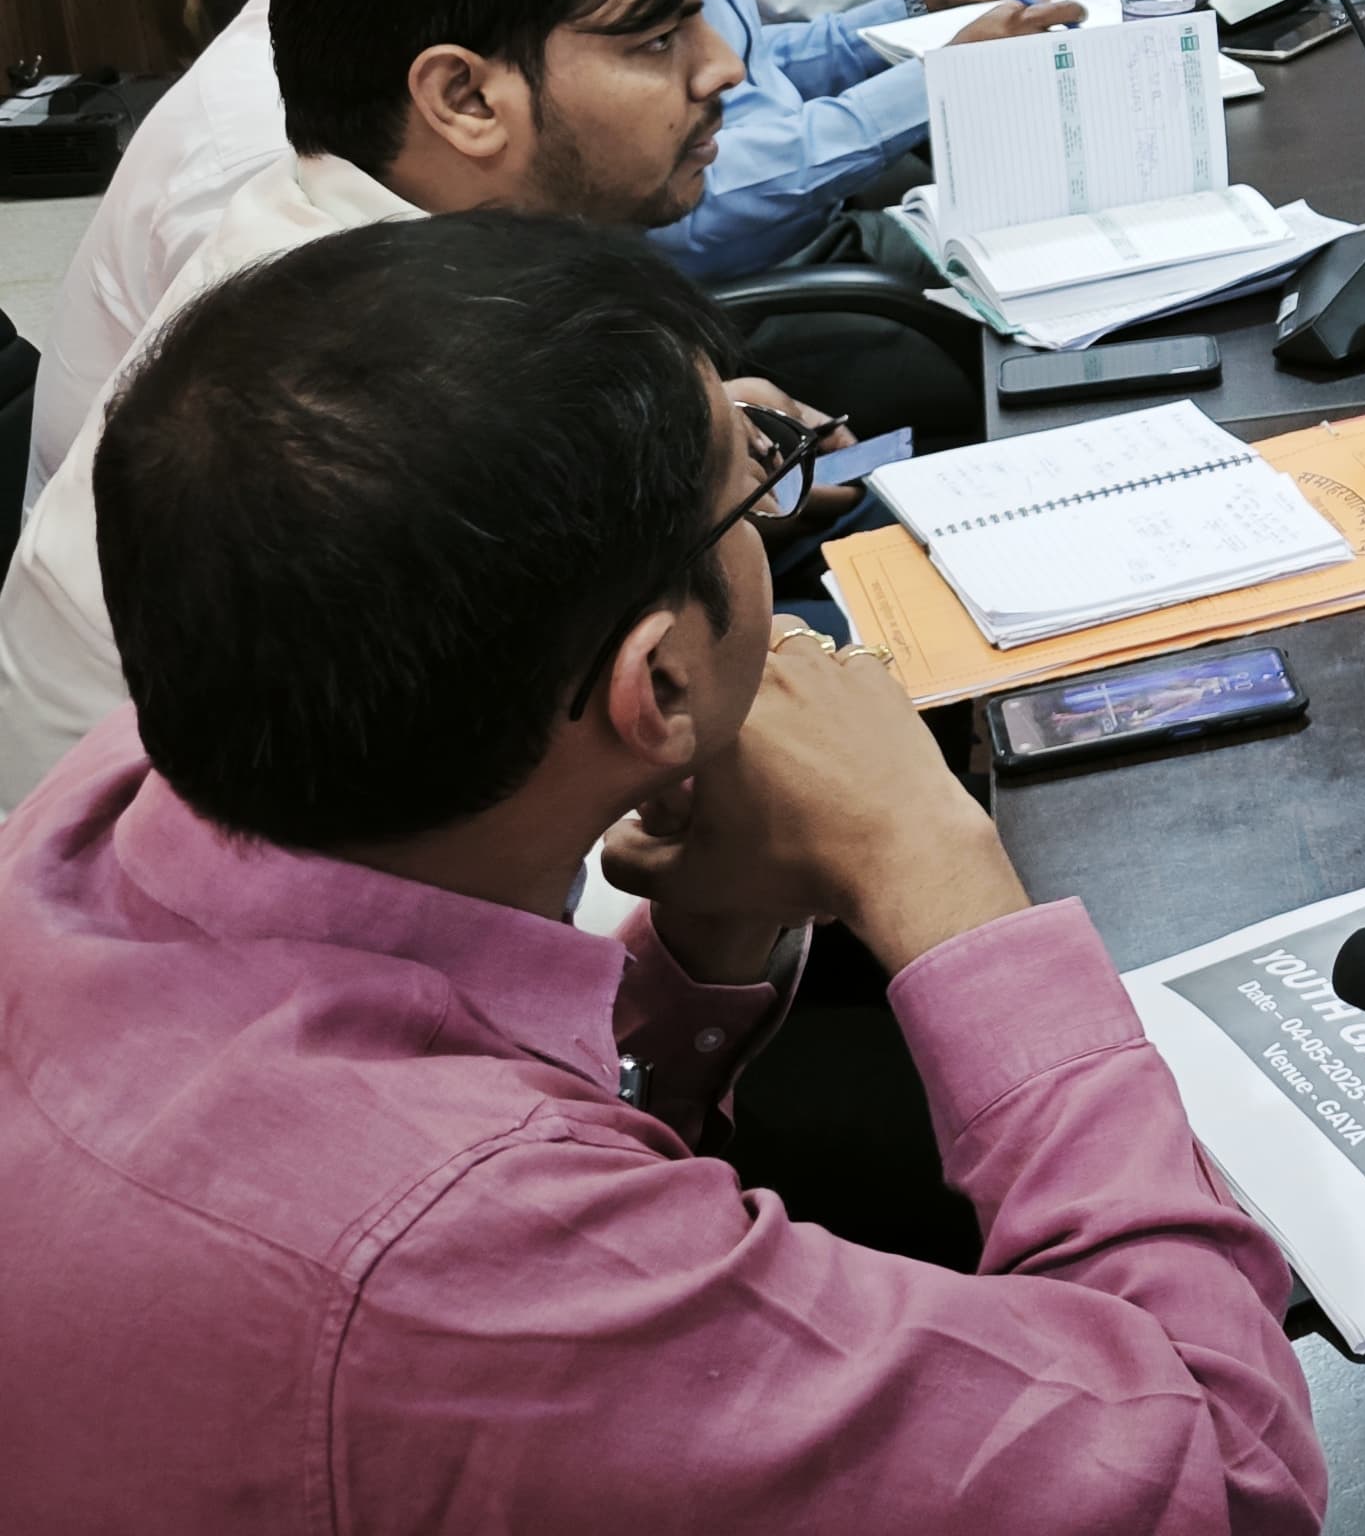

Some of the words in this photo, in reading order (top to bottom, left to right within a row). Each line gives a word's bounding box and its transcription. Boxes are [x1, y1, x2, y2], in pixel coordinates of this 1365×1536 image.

[1237, 980, 1278, 1012] Date
[1252, 948, 1362, 1022] YOUTH
[1262, 1041, 1314, 1094] Venue
